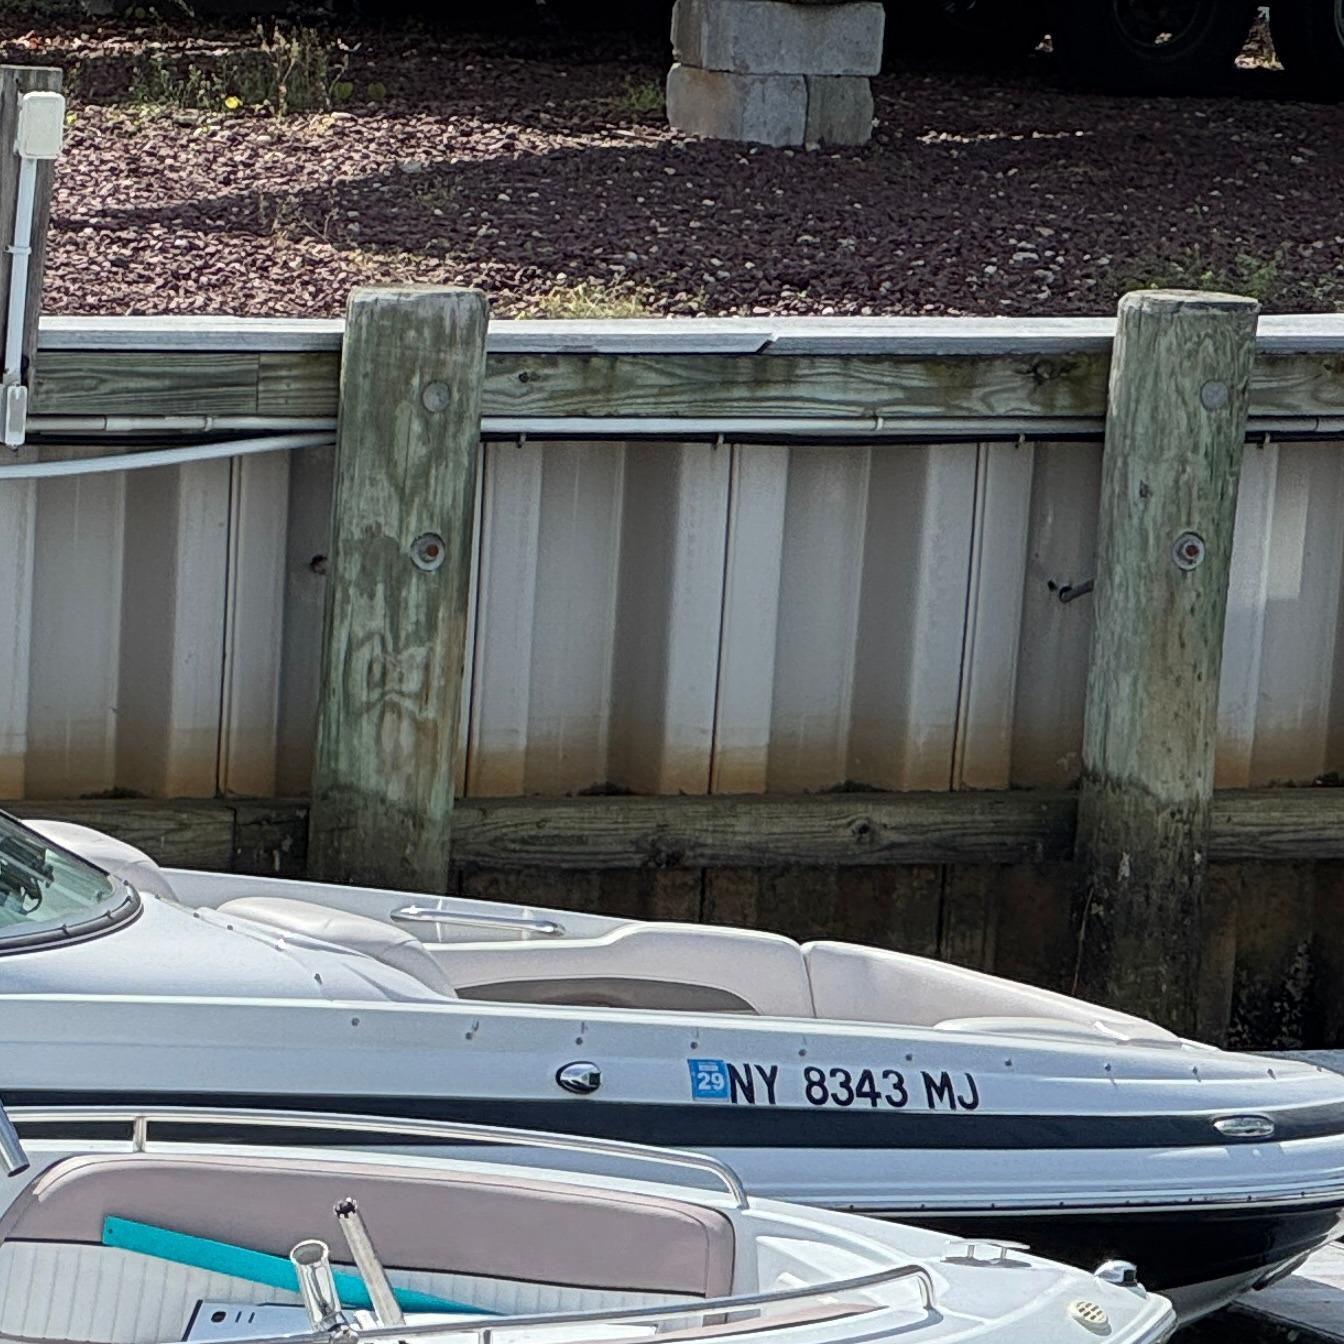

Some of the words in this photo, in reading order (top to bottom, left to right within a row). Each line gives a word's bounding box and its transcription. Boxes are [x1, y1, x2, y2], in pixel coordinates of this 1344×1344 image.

[697, 1071, 726, 1091] 29
[726, 1062, 779, 1105] NY
[803, 1065, 909, 1108] 8343
[920, 1070, 980, 1111] MJ
